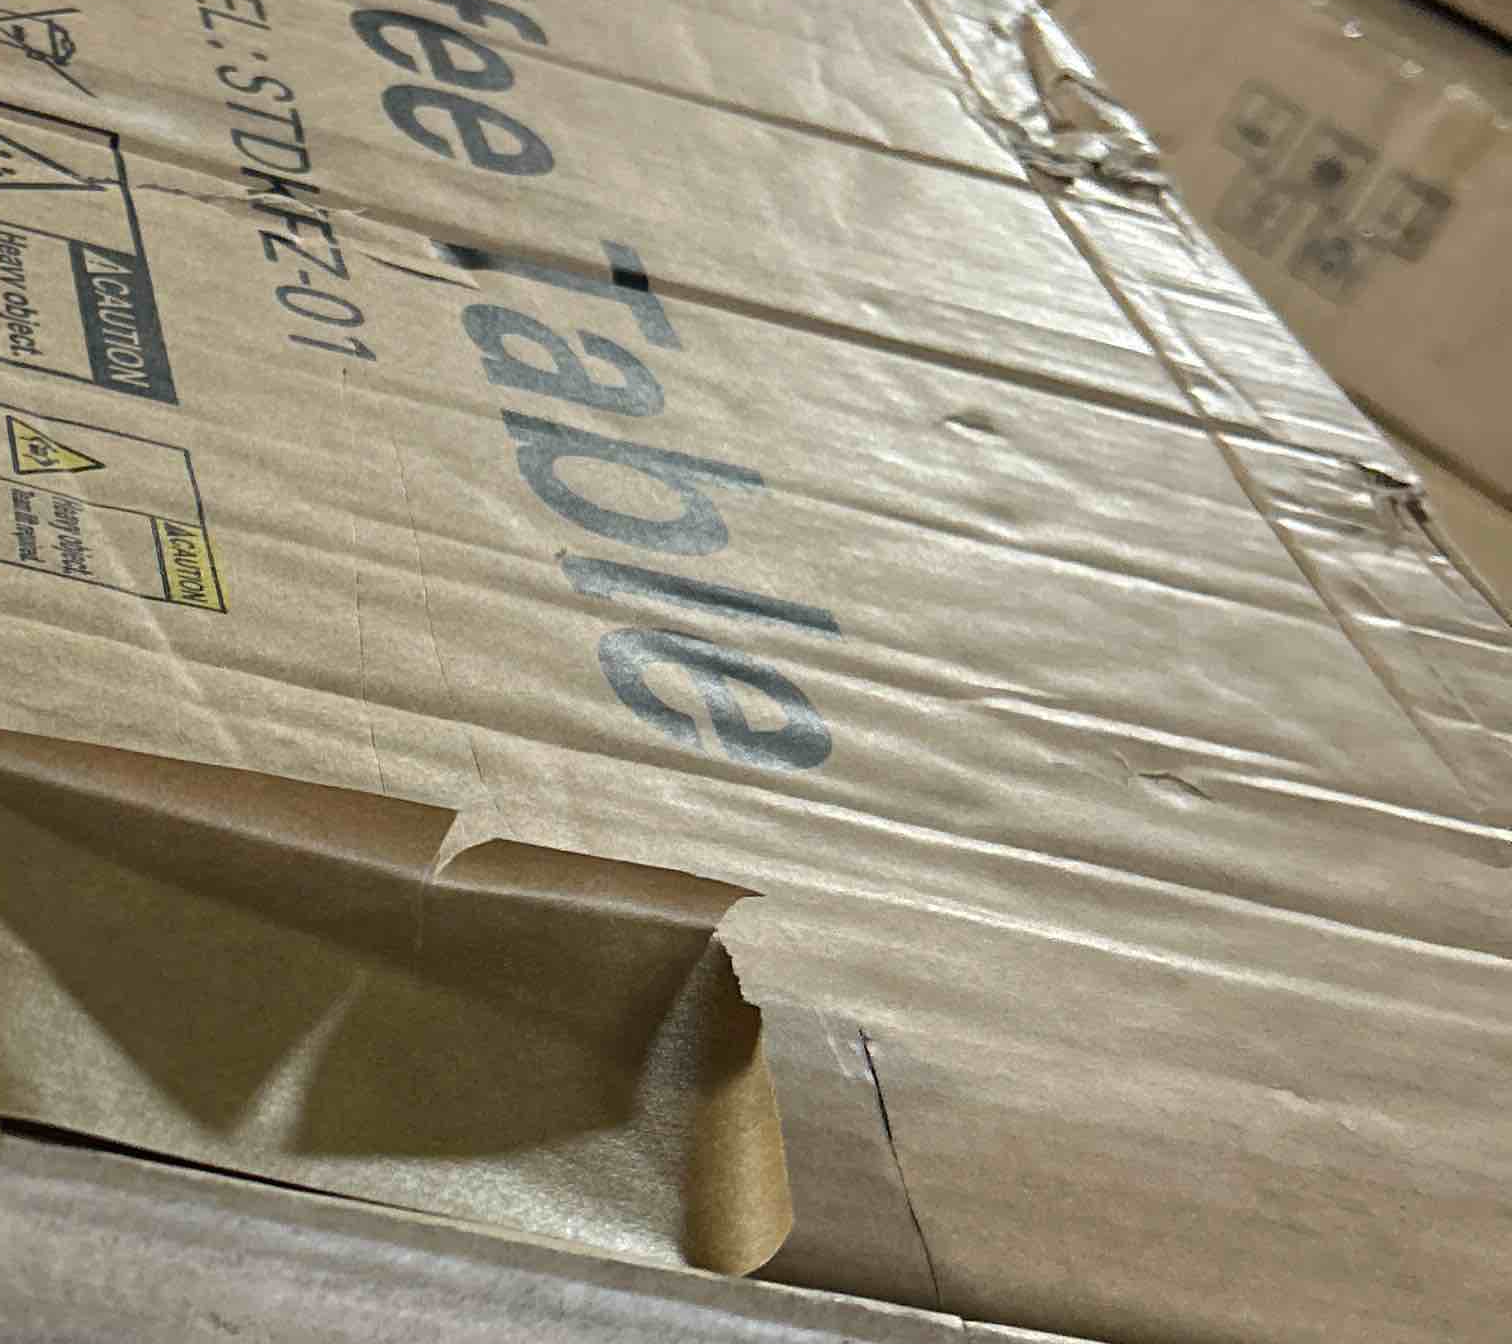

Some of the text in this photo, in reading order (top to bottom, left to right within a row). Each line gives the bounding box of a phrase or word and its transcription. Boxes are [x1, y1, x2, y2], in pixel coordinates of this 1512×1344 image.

[91, 276, 151, 389] CAUTION
[432, 238, 842, 772] Table
[169, 536, 209, 603] CAUTION
